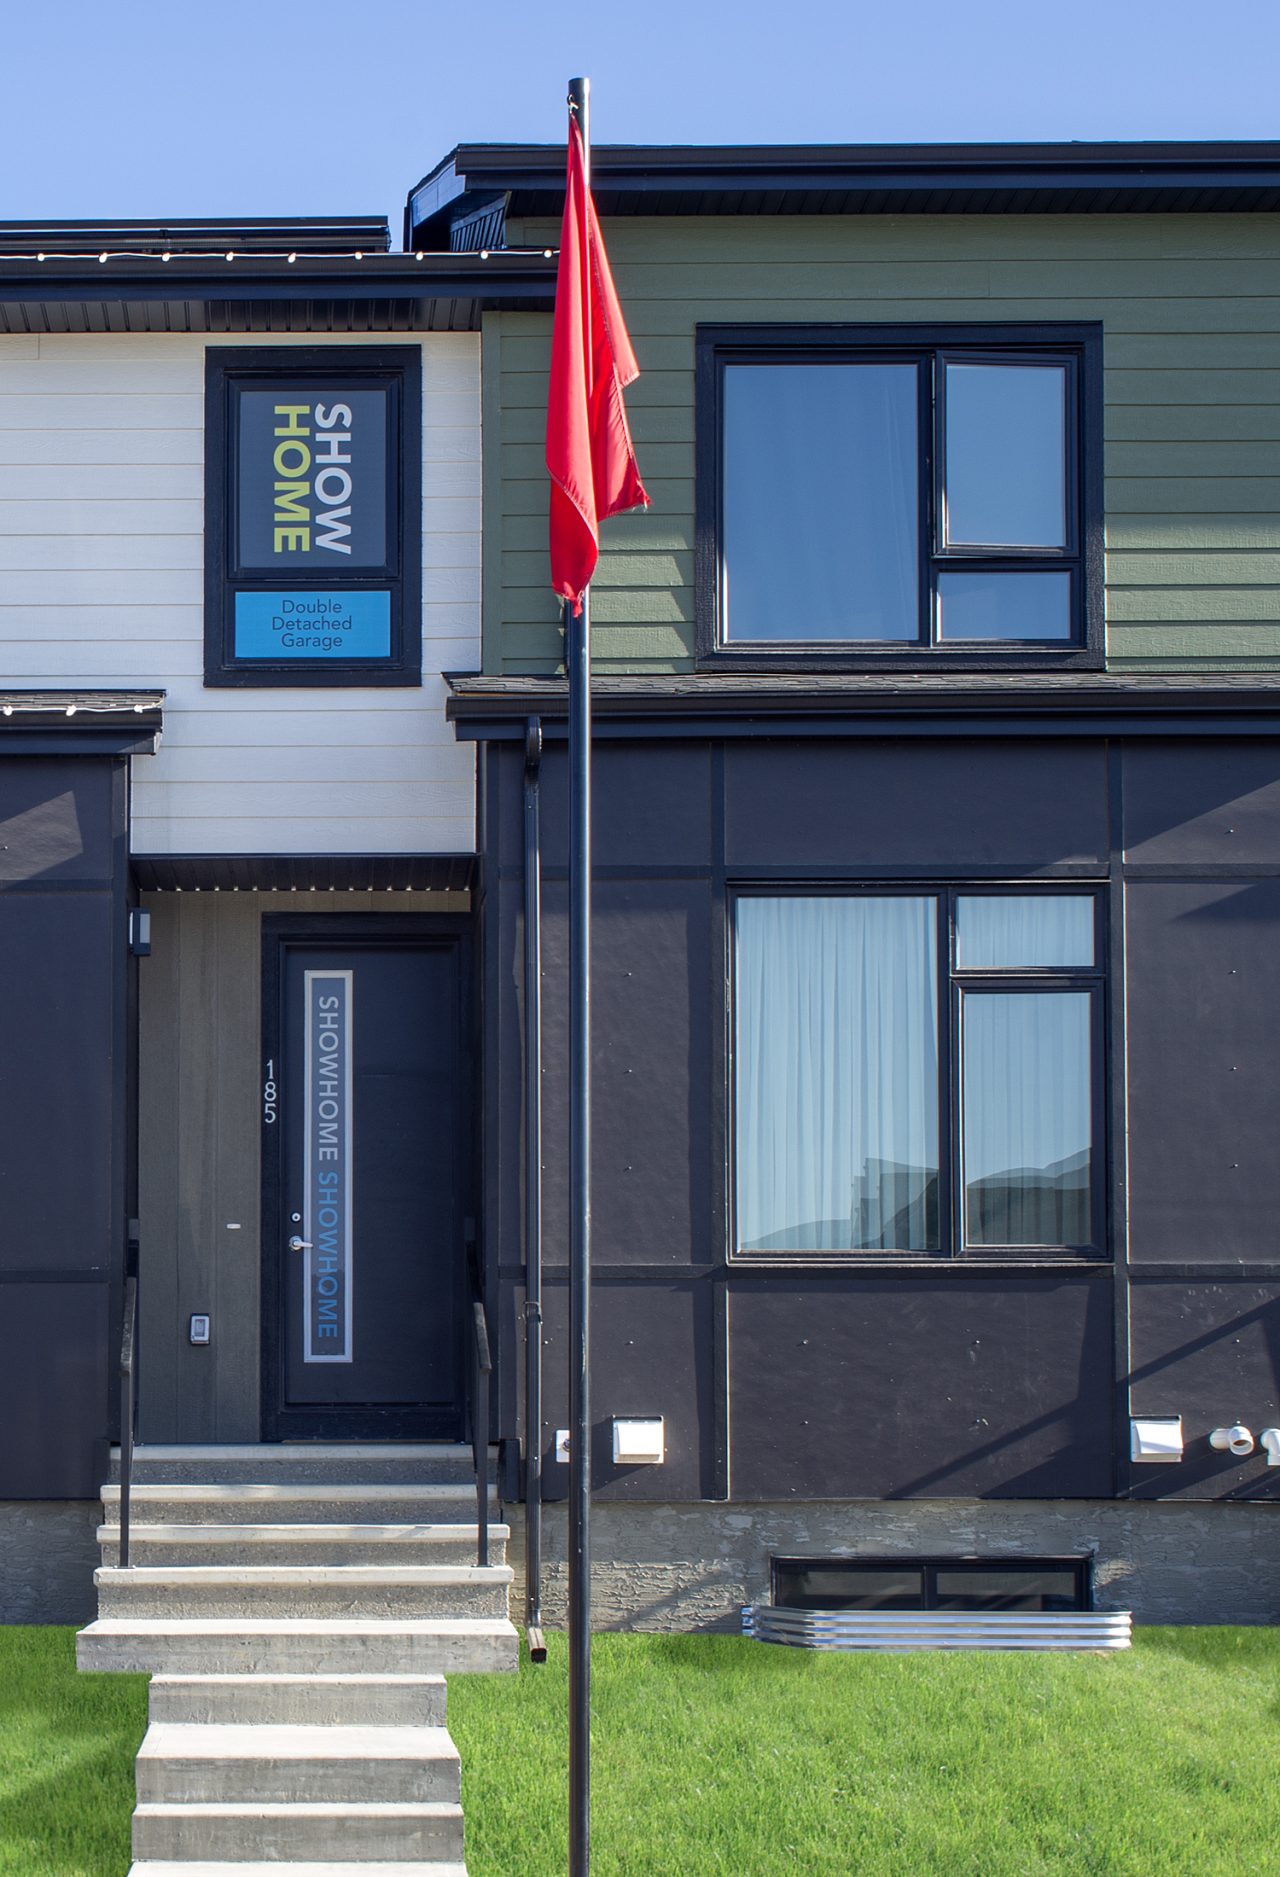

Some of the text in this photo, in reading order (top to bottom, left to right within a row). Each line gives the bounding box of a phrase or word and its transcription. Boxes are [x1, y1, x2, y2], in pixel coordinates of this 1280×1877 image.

[273, 405, 311, 553] HOME
[314, 403, 353, 555] SHOW
[272, 616, 352, 631] Detached
[282, 599, 343, 614] Double
[281, 633, 343, 651] Garage
[263, 1059, 277, 1124] 185
[317, 995, 339, 1338] SHOWHOME SHOWHOME
